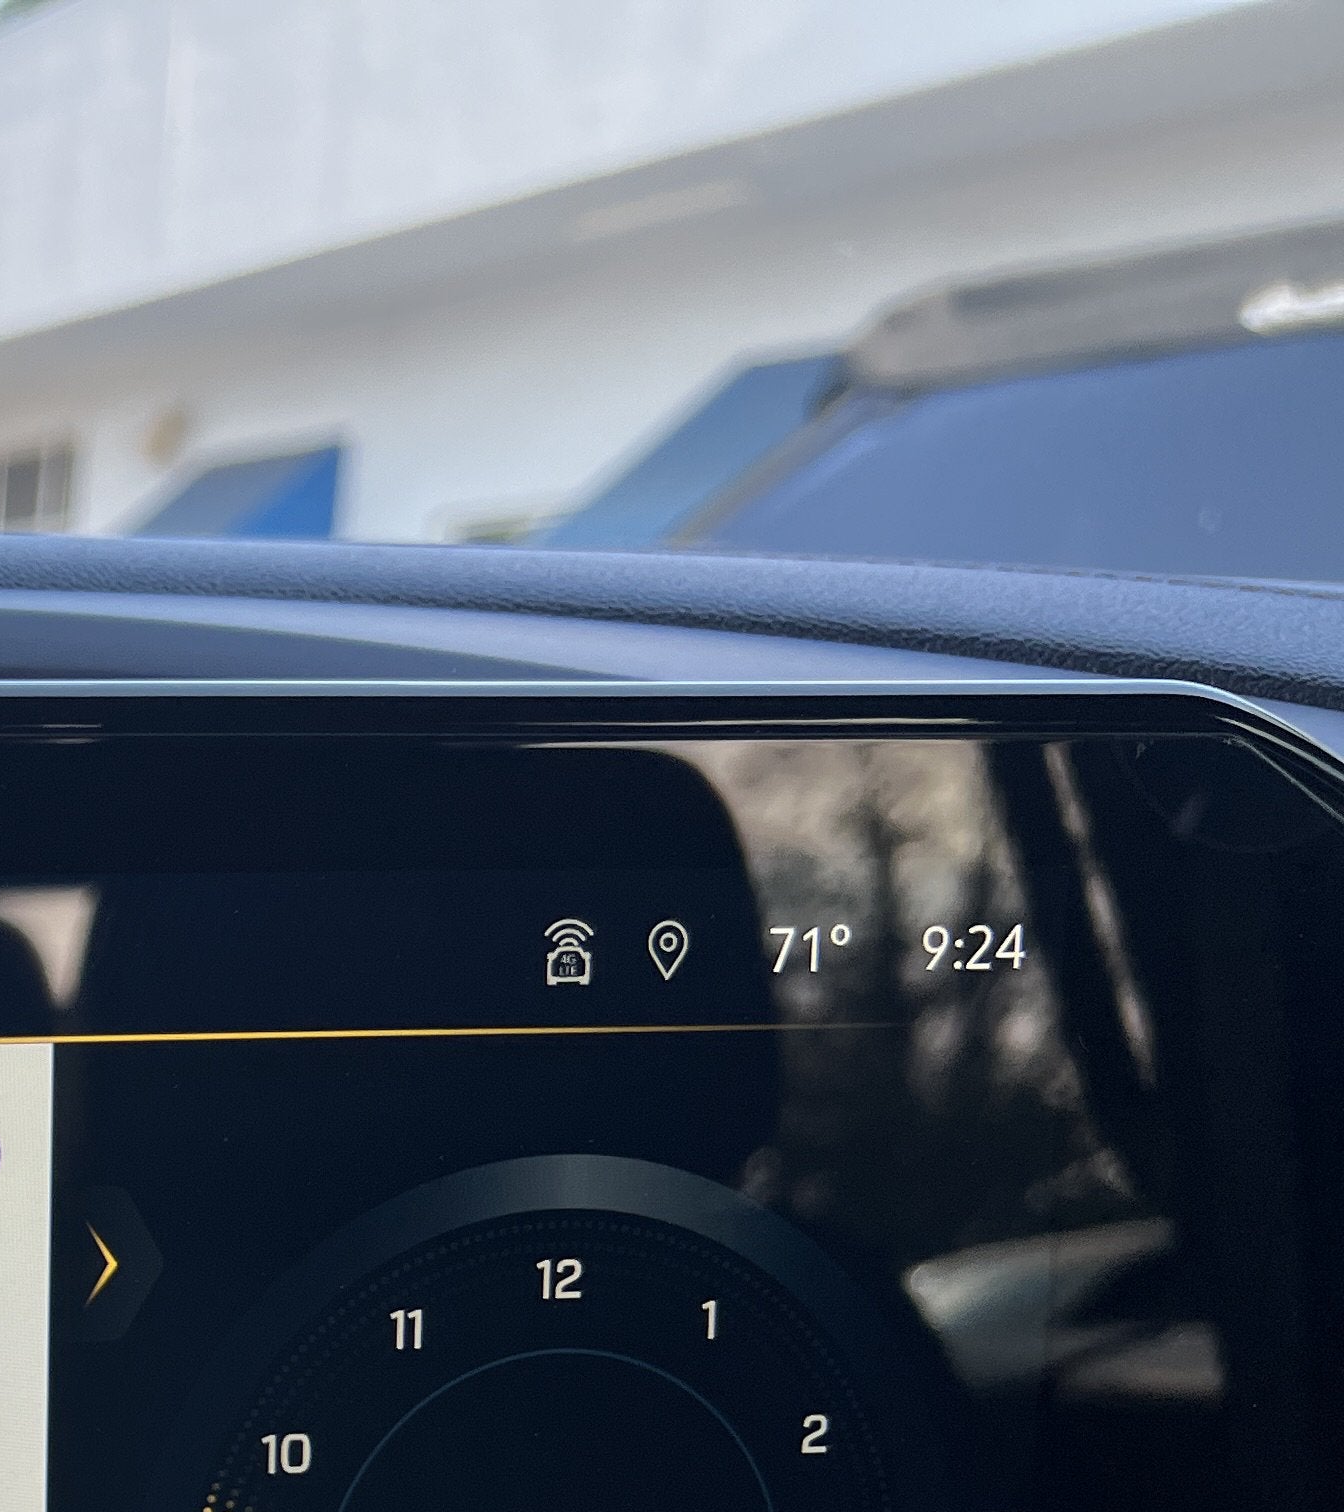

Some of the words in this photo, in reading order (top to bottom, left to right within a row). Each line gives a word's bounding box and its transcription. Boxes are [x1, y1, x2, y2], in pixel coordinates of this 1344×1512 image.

[921, 924, 1026, 972] 9:24
[536, 1258, 583, 1300] 12
[389, 1308, 423, 1350] 11
[700, 1300, 717, 1340] 1
[261, 1433, 312, 1475] 10
[800, 1414, 828, 1454] 2
